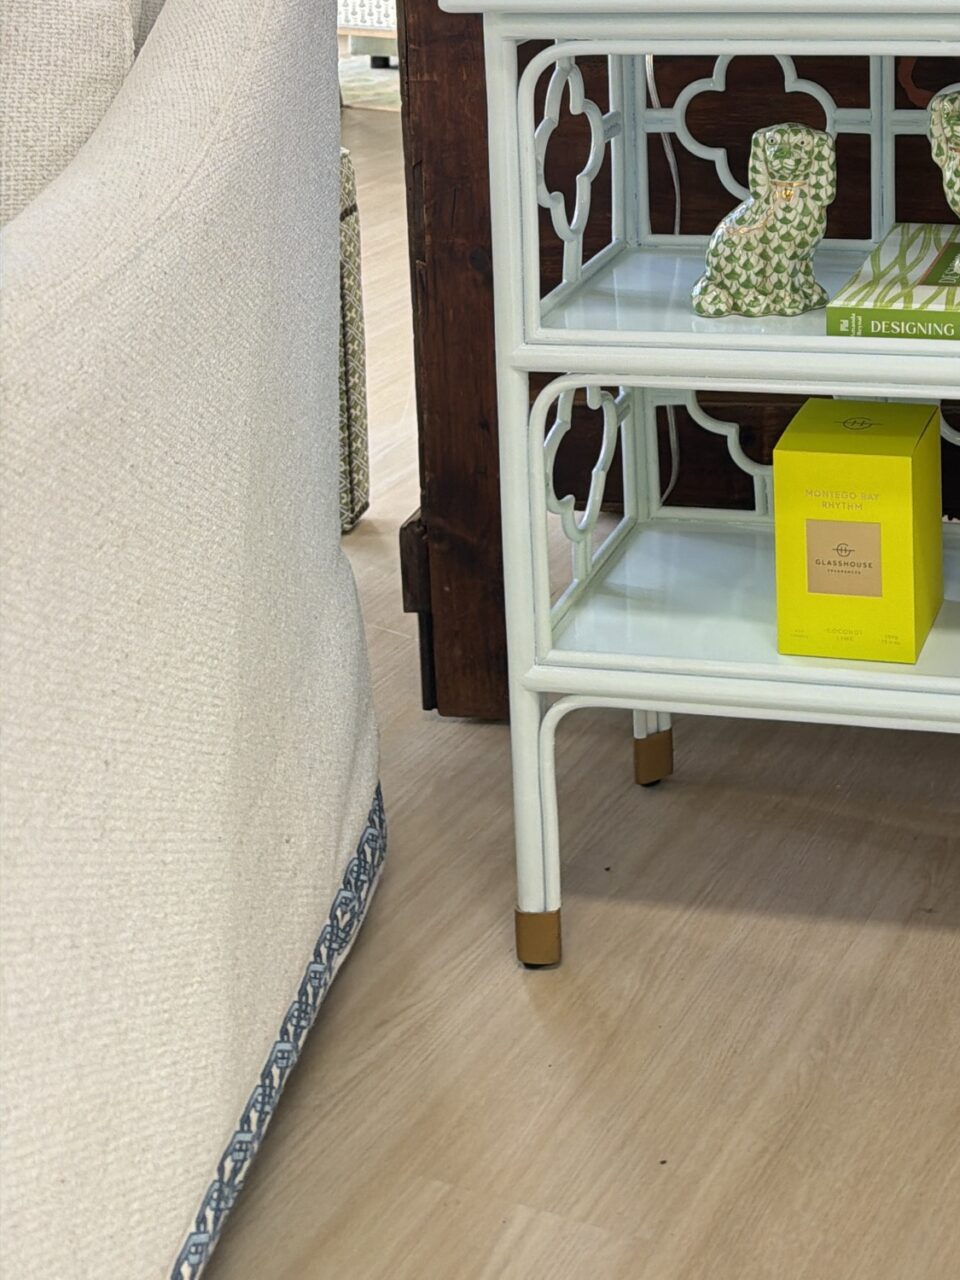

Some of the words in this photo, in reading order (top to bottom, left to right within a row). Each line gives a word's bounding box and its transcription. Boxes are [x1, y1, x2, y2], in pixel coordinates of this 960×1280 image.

[870, 320, 956, 337] DESIGNING
[805, 488, 857, 500] MONTEGO
[821, 500, 863, 511] RHYTHM
[815, 558, 873, 569] GLASSHOUSE
